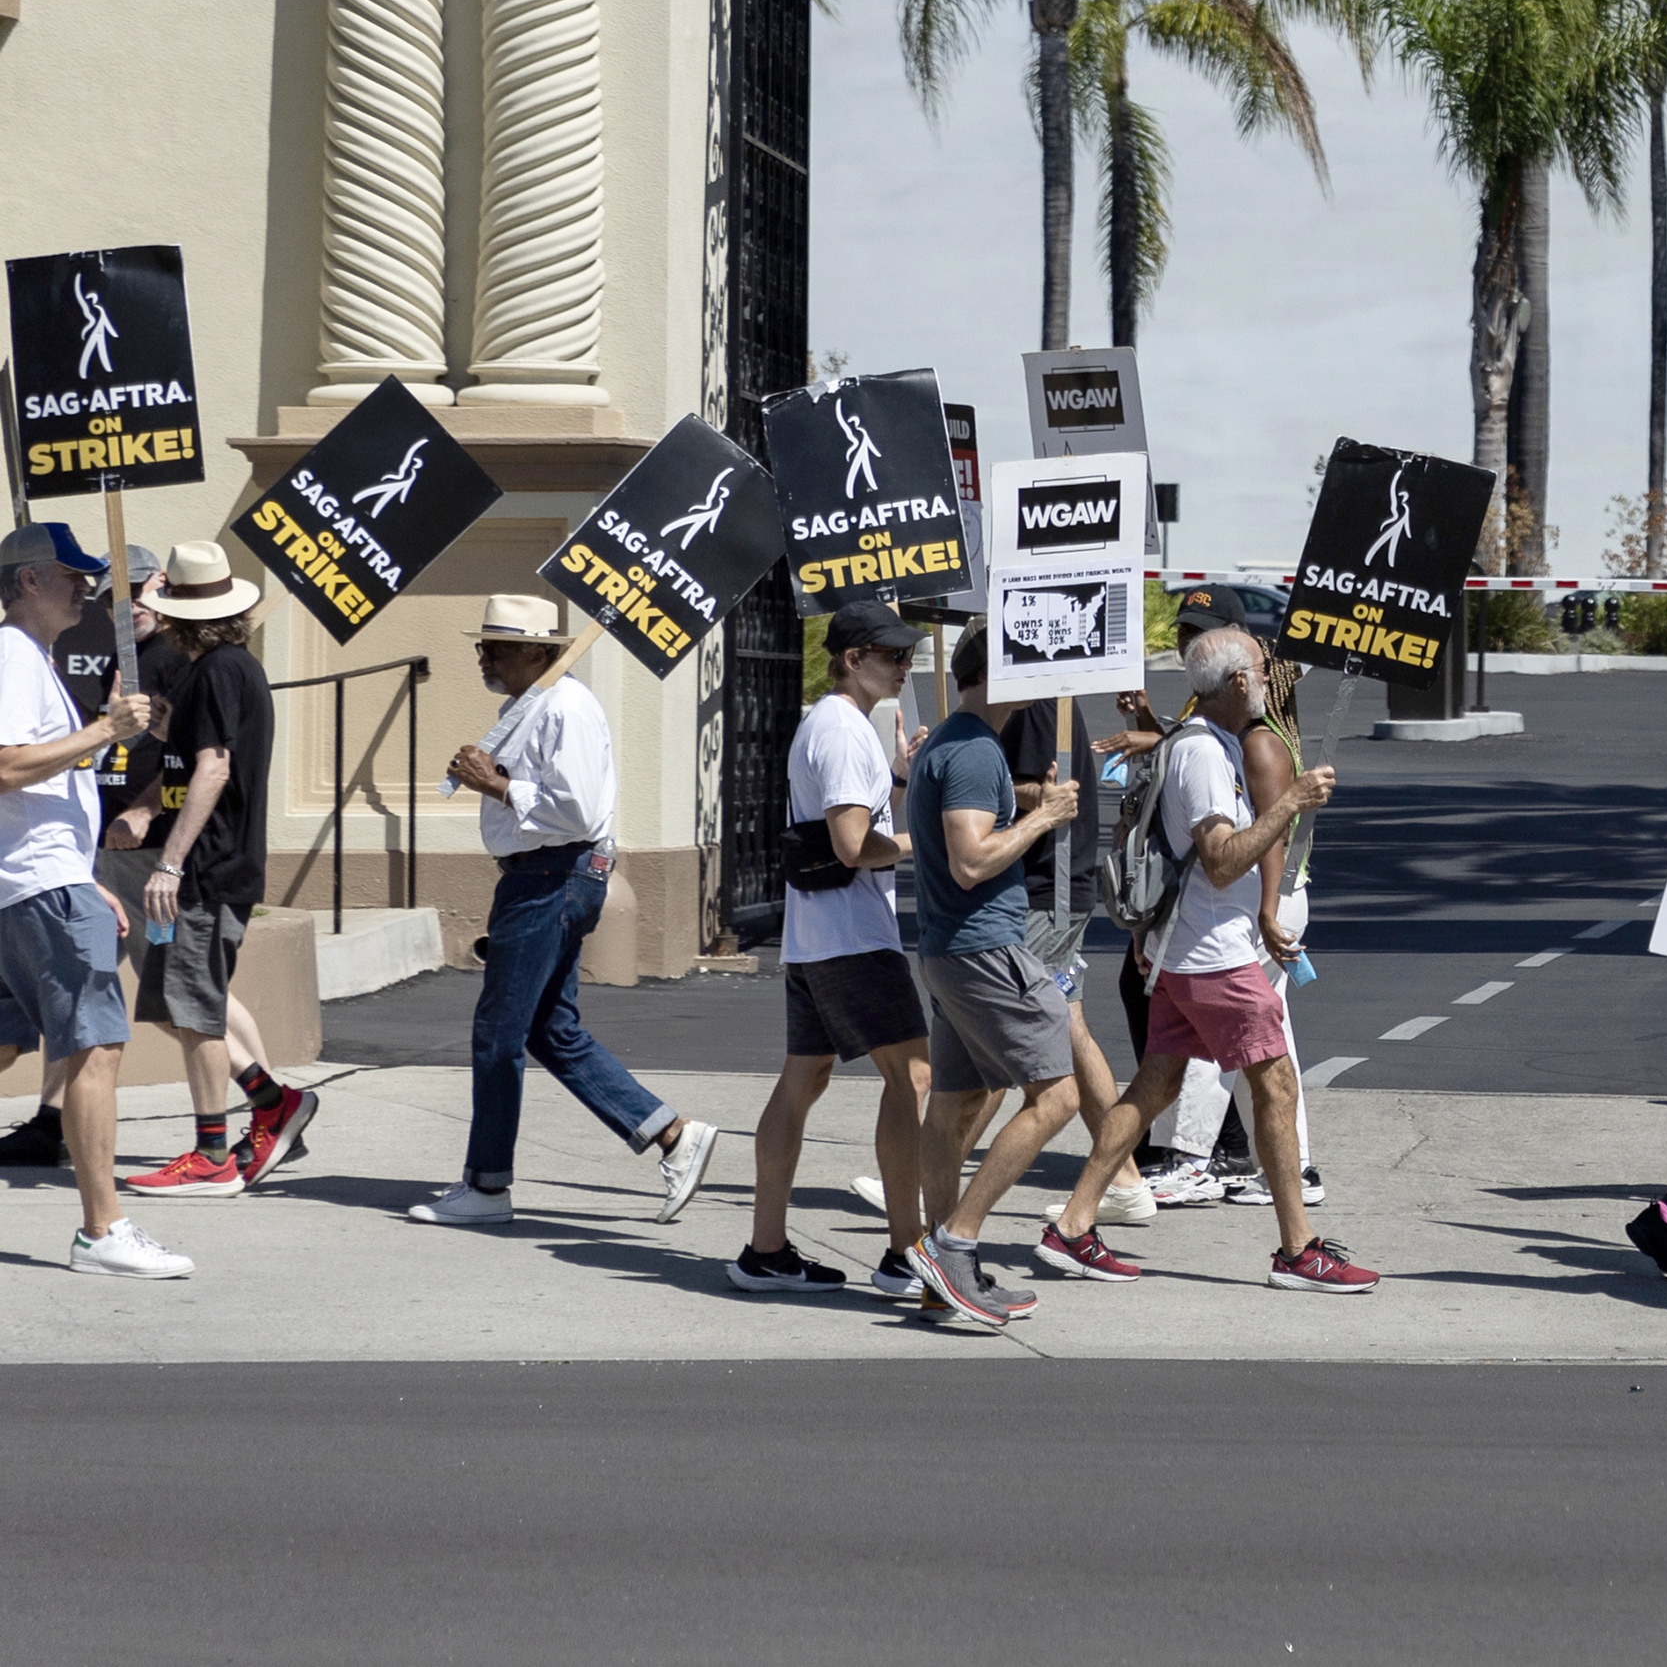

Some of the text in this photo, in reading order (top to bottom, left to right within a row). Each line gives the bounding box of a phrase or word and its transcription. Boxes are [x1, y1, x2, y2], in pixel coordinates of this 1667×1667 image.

[1046, 387, 1118, 412] WGAW
[88, 416, 122, 435] ON
[28, 428, 195, 475] STRIKE!
[1021, 498, 1118, 530] WGAW
[316, 530, 345, 559] ON
[858, 531, 892, 550] ON
[252, 501, 376, 625] STRIKE!
[799, 540, 962, 594] STRIKE!
[627, 564, 658, 592] ON
[560, 543, 692, 660] STRIKE!
[1021, 595, 1037, 607] 1%
[1352, 603, 1384, 624] ON
[1017, 629, 1039, 641] 43%
[1286, 609, 1440, 669] STRIKE!
[922, 1235, 939, 1260] HOKA
